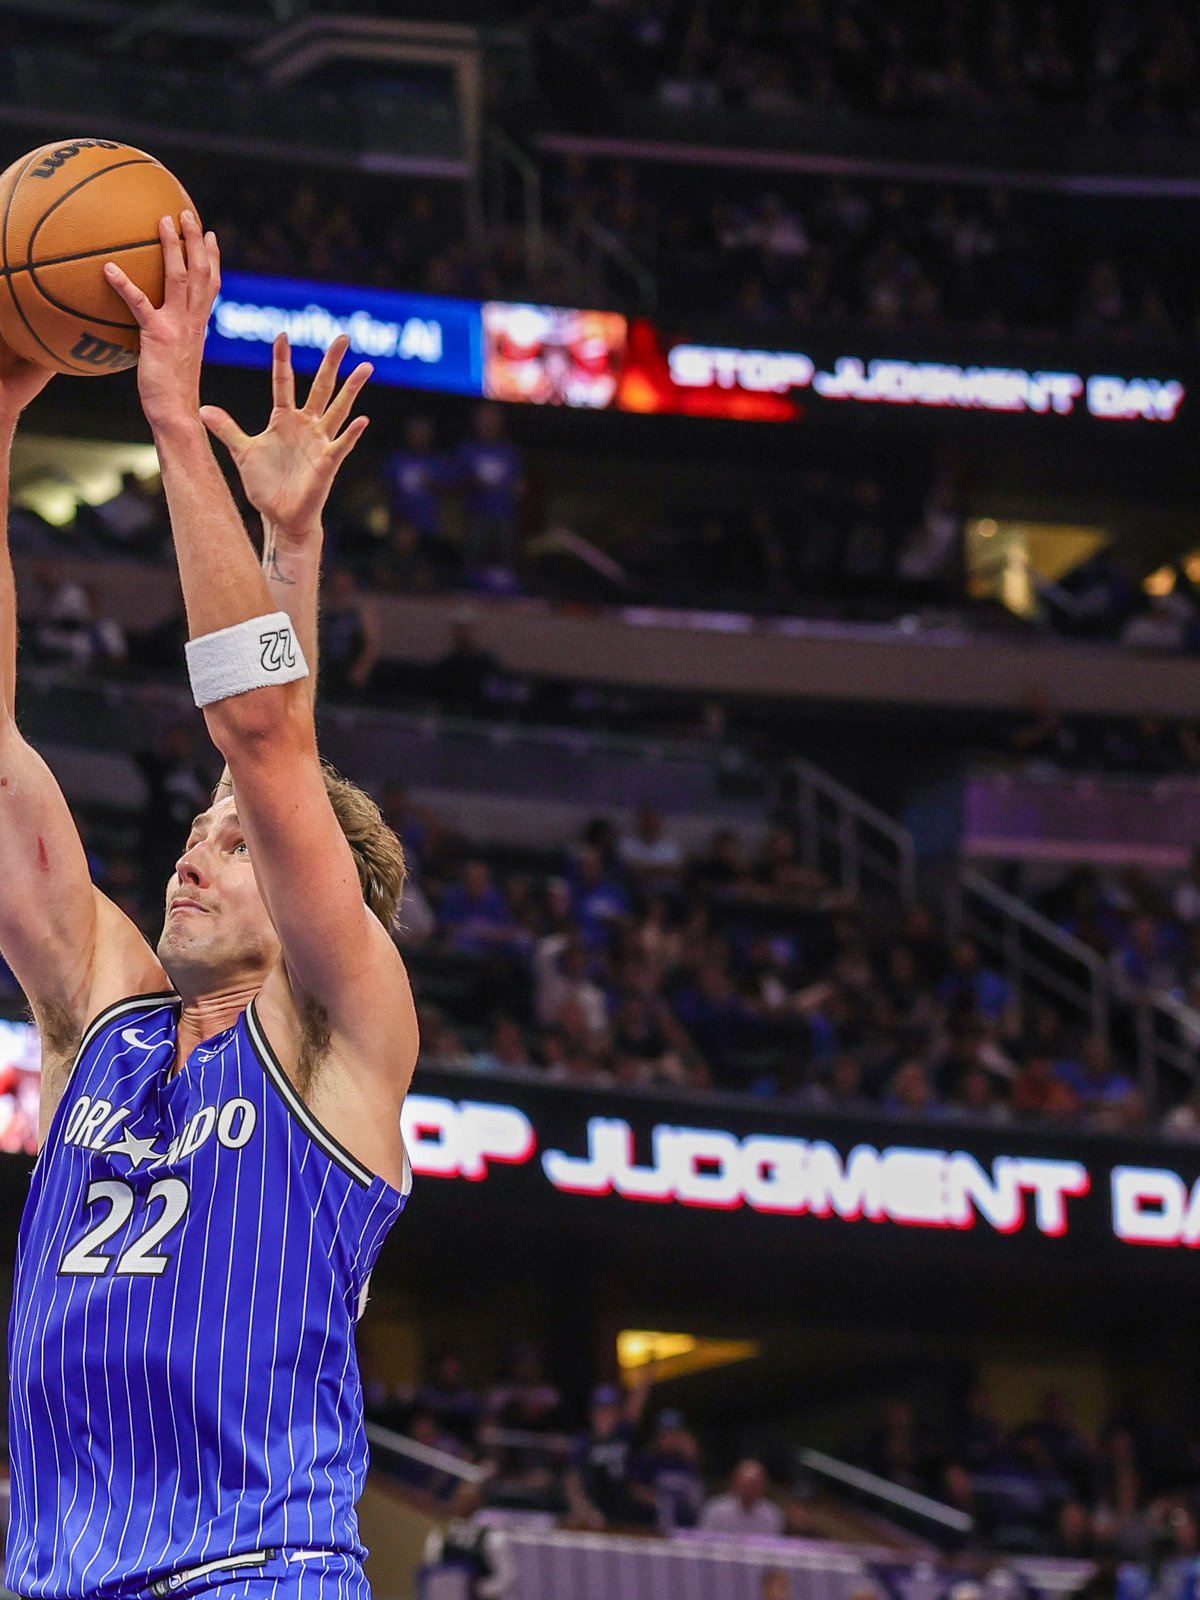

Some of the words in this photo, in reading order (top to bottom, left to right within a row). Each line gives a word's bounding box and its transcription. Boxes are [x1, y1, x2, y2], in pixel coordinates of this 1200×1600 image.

[398, 317, 443, 363] AI
[668, 344, 815, 393] STOP
[812, 357, 1083, 414] JUDGMENT
[1087, 375, 1184, 422] DAY
[260, 628, 296, 672] 22
[541, 1116, 1091, 1237] JUDGMENT
[57, 1177, 192, 1276] 22
